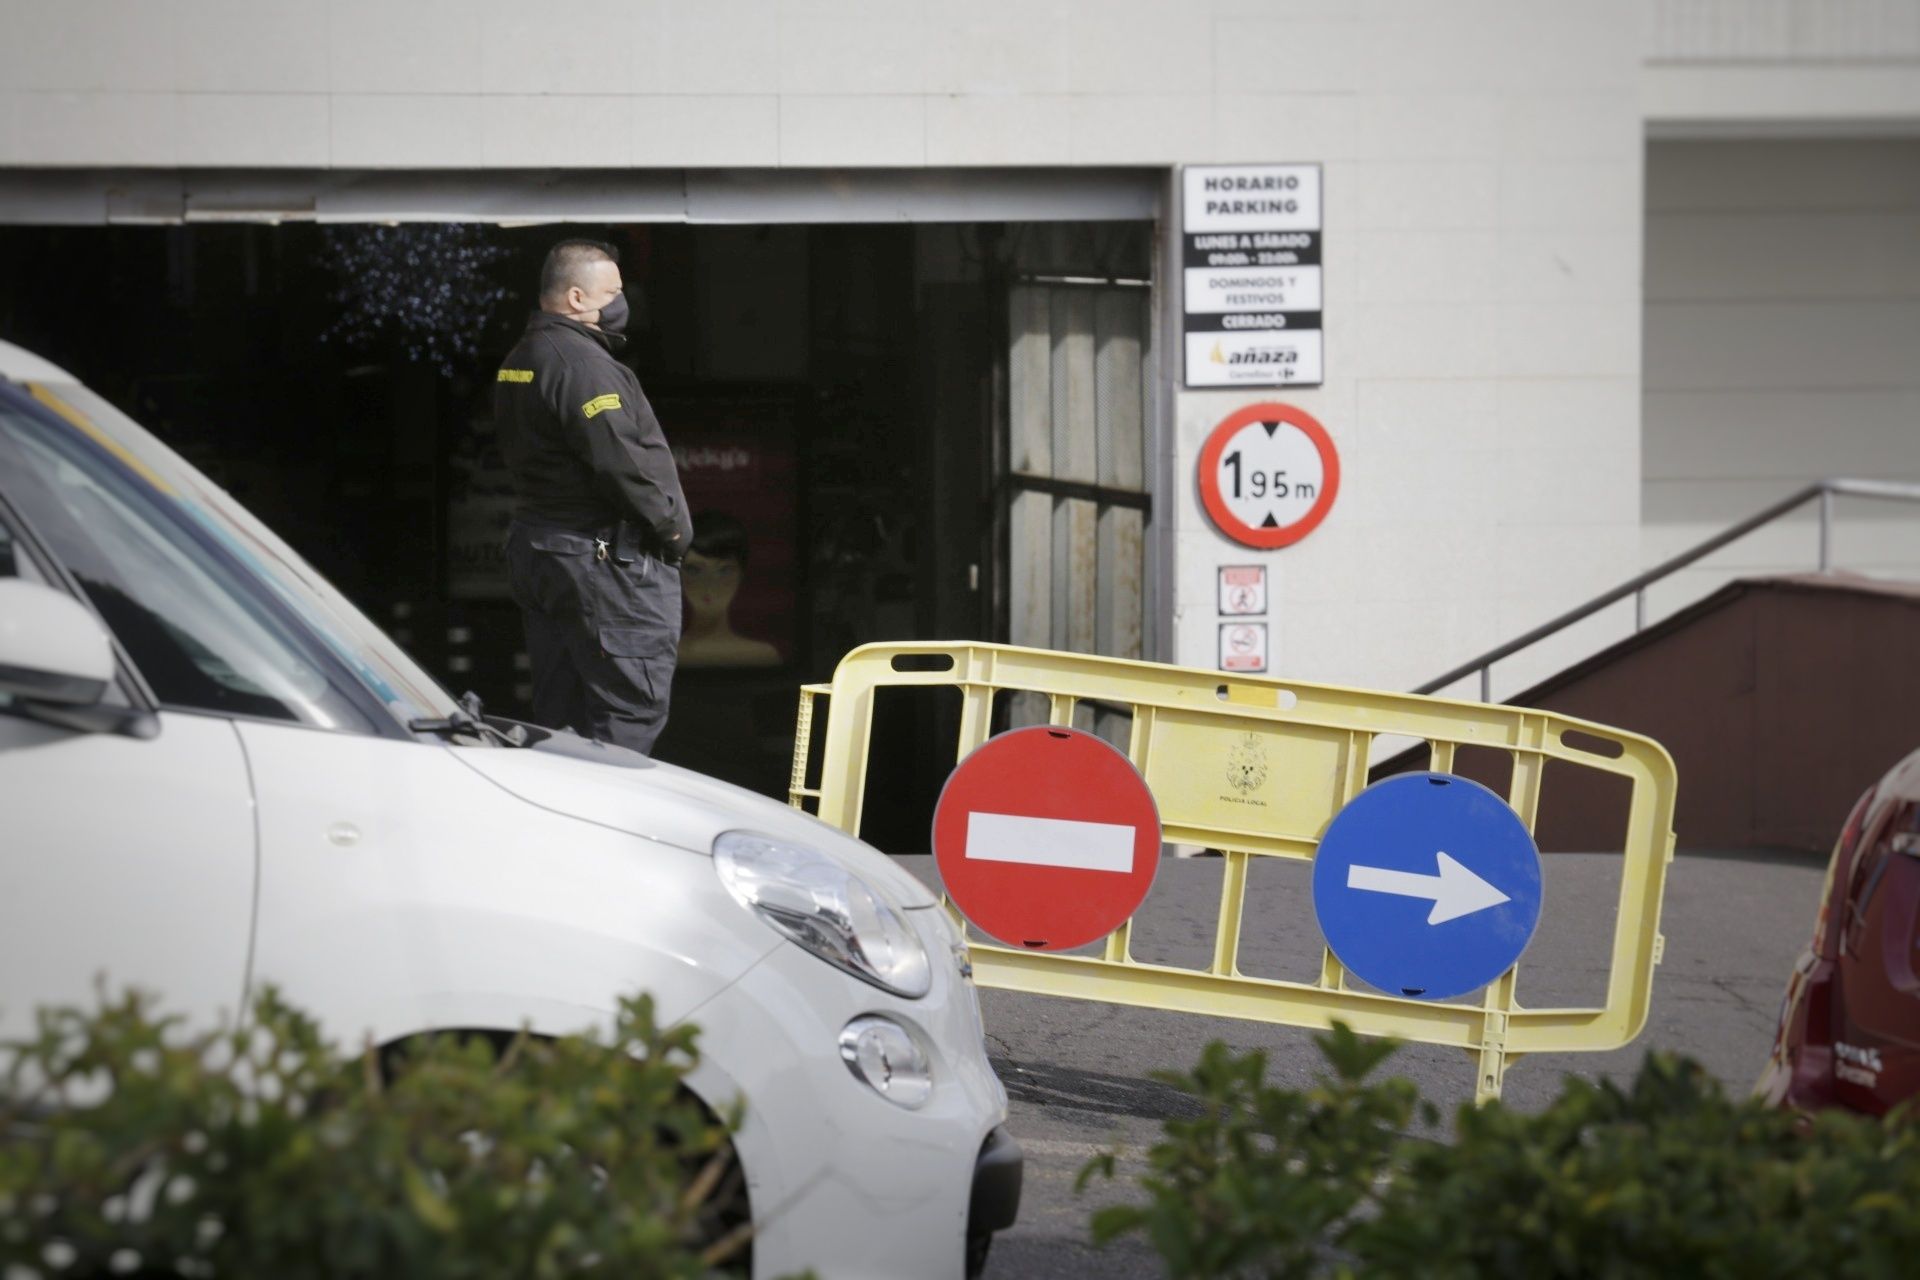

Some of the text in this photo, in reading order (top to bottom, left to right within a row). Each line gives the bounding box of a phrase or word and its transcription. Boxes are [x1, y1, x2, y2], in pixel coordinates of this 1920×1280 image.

[1204, 176, 1299, 191] HORARIO
[1206, 200, 1297, 214] PARKING
[1194, 232, 1311, 249] LUNES A SÁBADO
[1209, 277, 1296, 288] DOMINGOS Y
[1226, 294, 1285, 304] FESTIVOS
[1221, 313, 1286, 329] CERRADO
[1229, 347, 1298, 364] añaza
